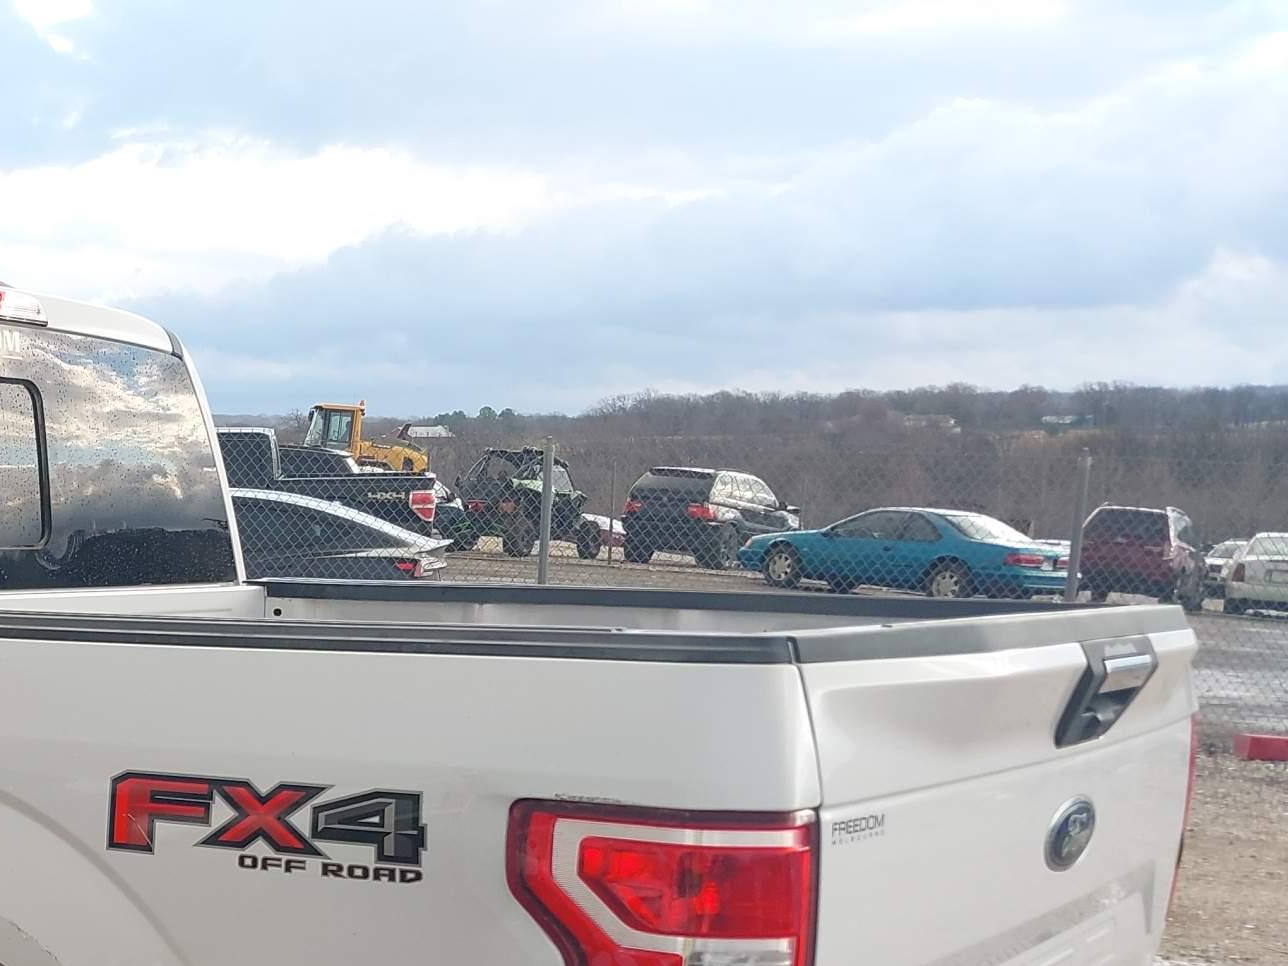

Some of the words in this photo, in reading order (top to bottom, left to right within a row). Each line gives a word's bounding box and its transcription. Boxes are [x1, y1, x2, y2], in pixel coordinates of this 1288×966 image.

[105, 769, 428, 868] FX4
[832, 814, 886, 838] FREEDOM
[237, 854, 307, 874] OFF
[321, 861, 423, 884] ROAD
